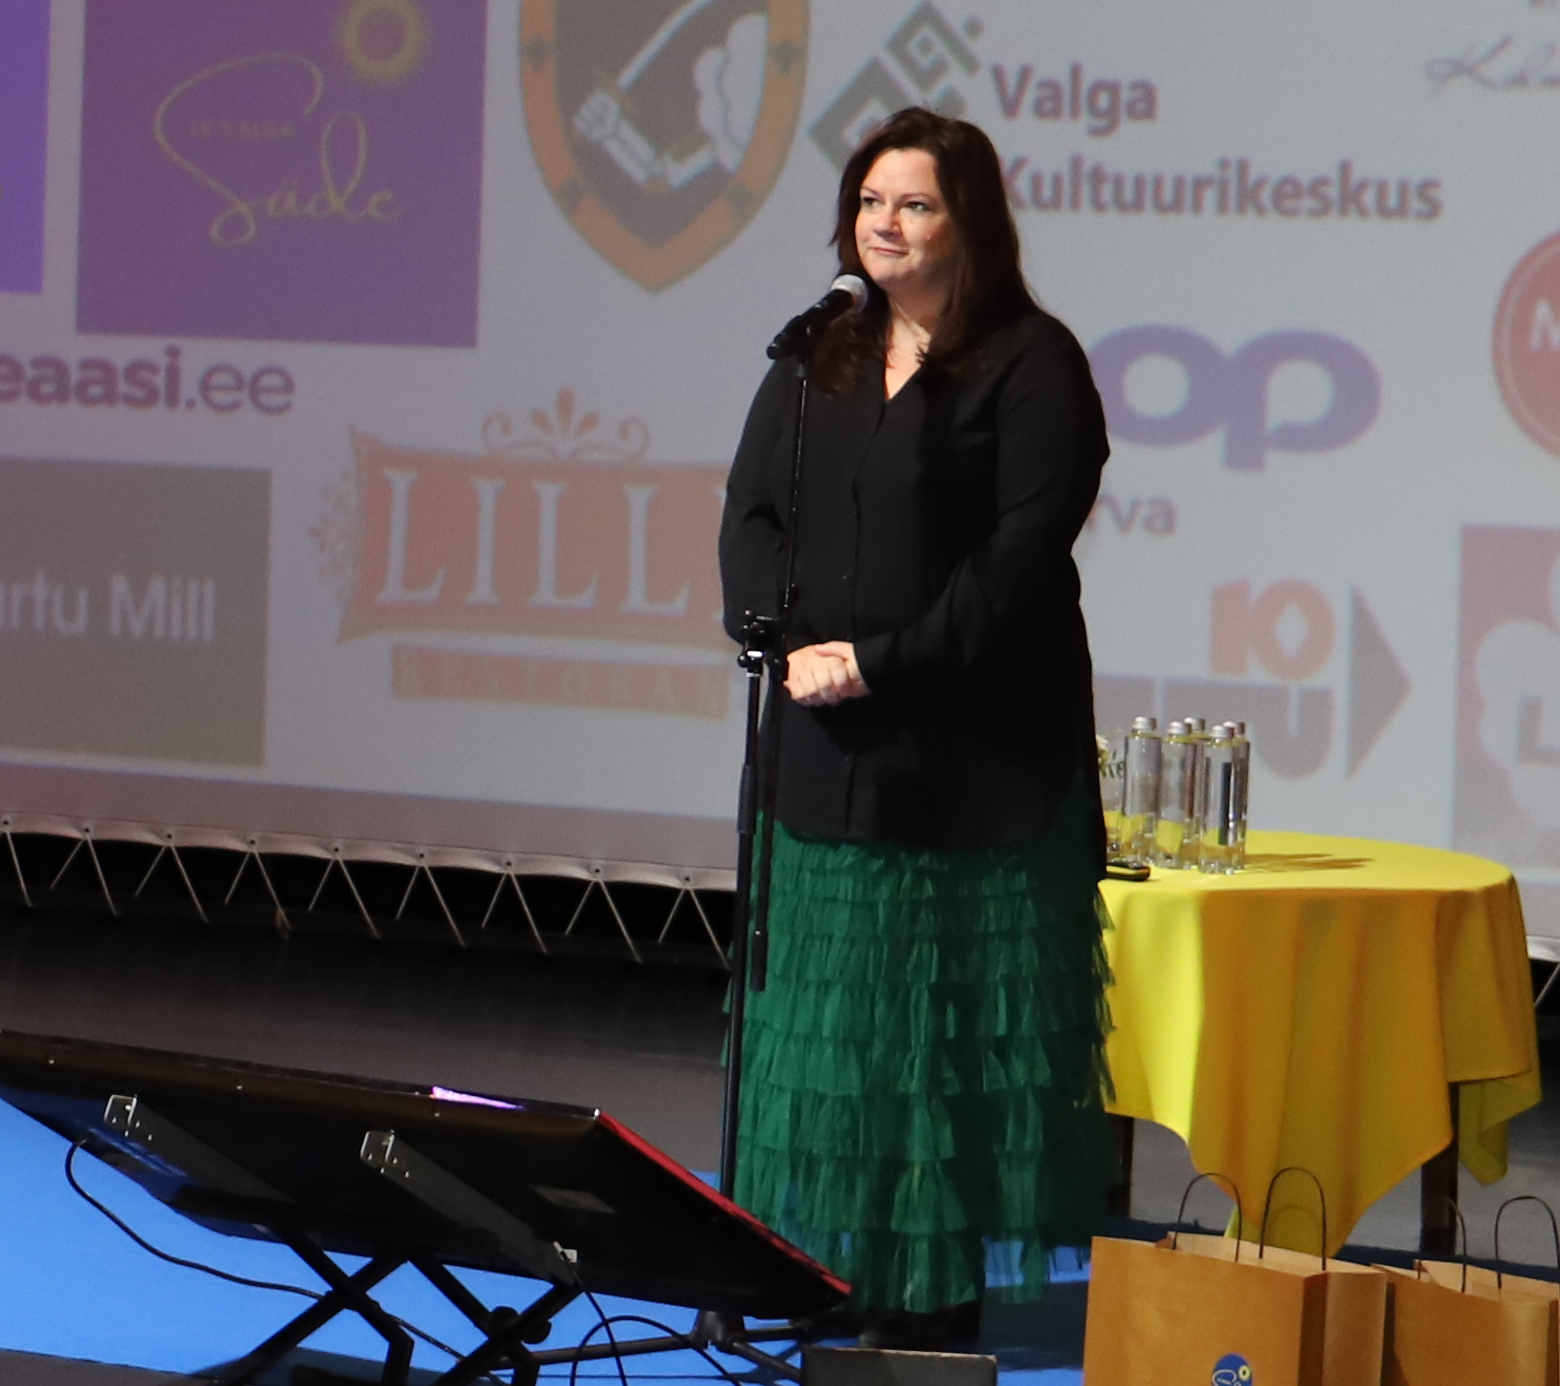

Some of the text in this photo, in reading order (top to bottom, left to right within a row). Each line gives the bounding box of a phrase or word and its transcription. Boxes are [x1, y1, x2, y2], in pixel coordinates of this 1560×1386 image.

[990, 61, 1158, 139] Valga
[374, 467, 724, 615] LILL
[108, 573, 216, 643] Mill
